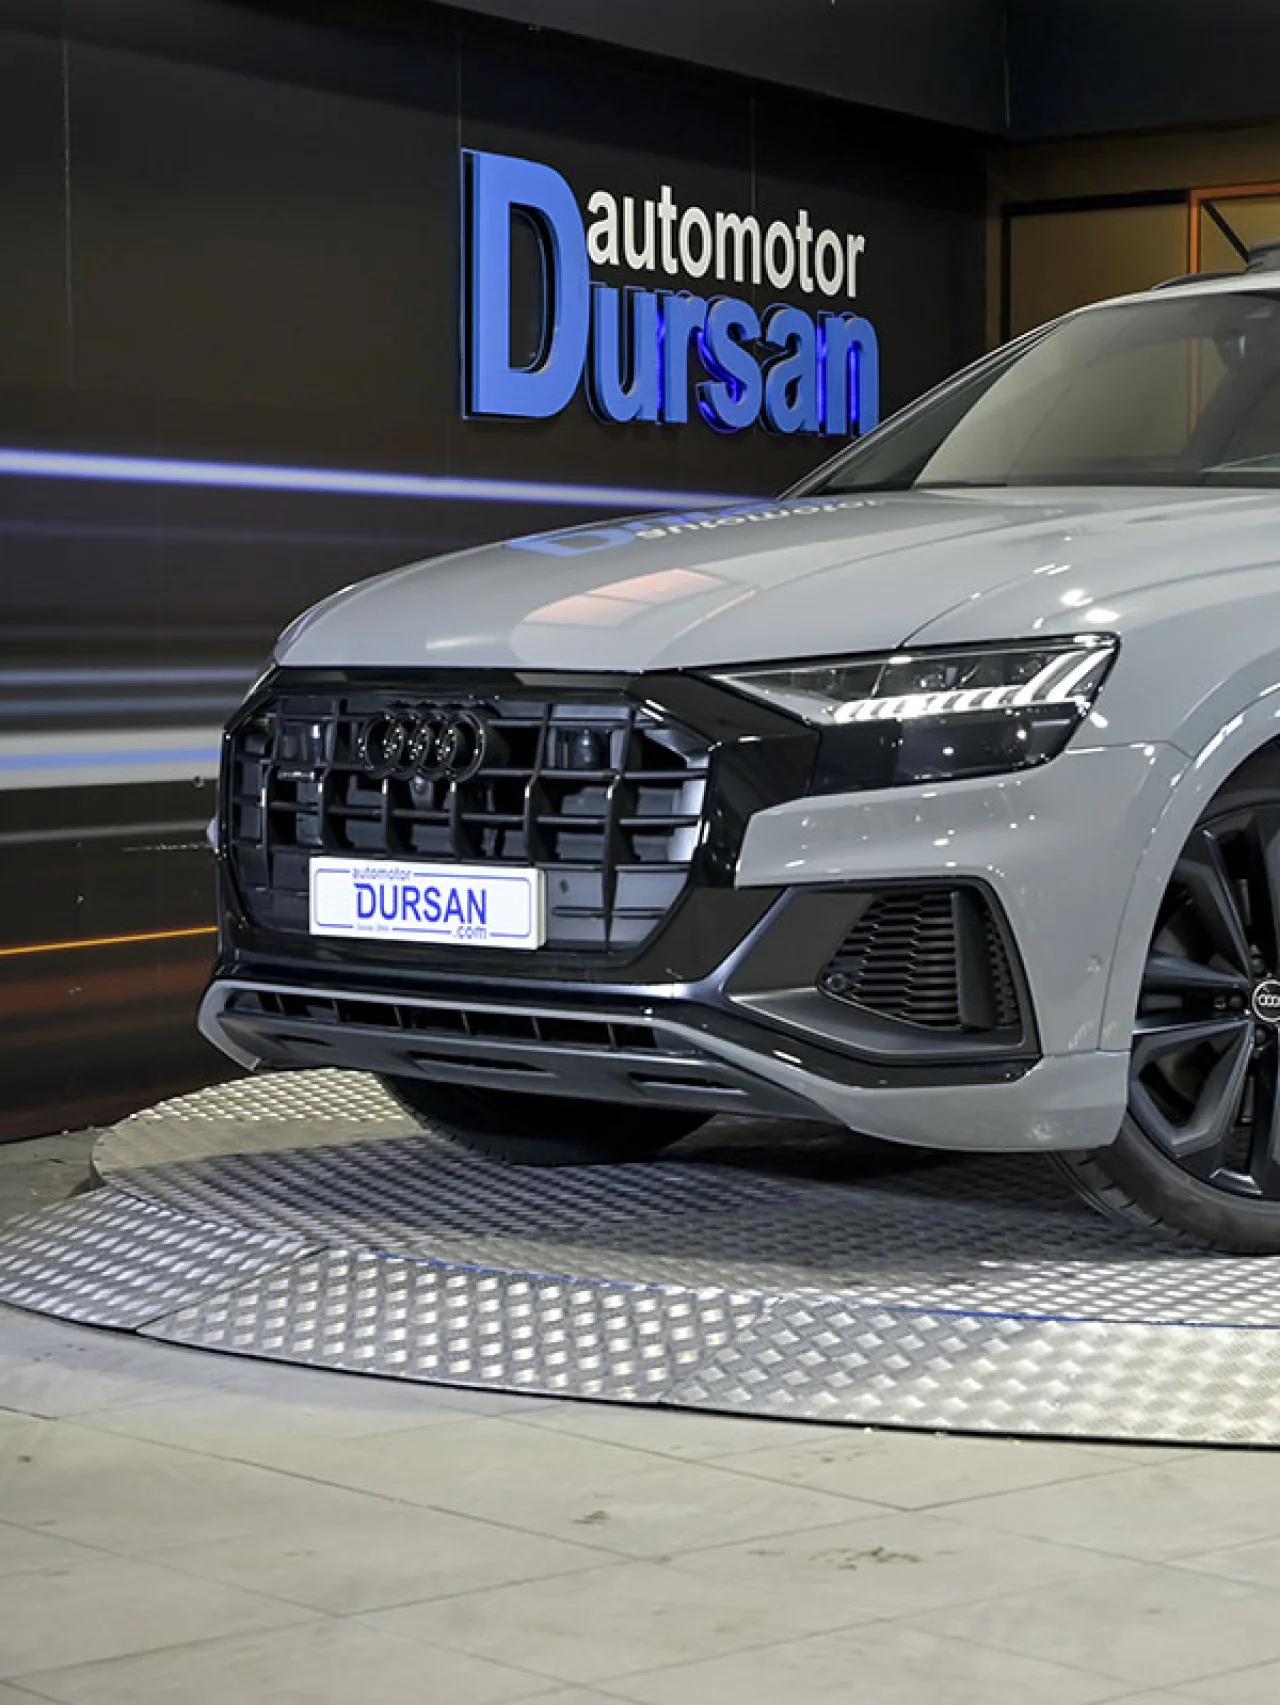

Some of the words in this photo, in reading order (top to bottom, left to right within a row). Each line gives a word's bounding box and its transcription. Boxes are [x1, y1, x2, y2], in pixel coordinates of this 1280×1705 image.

[461, 148, 880, 437] Dursan
[586, 185, 866, 298] automotor
[353, 882, 487, 925] DURSAN
